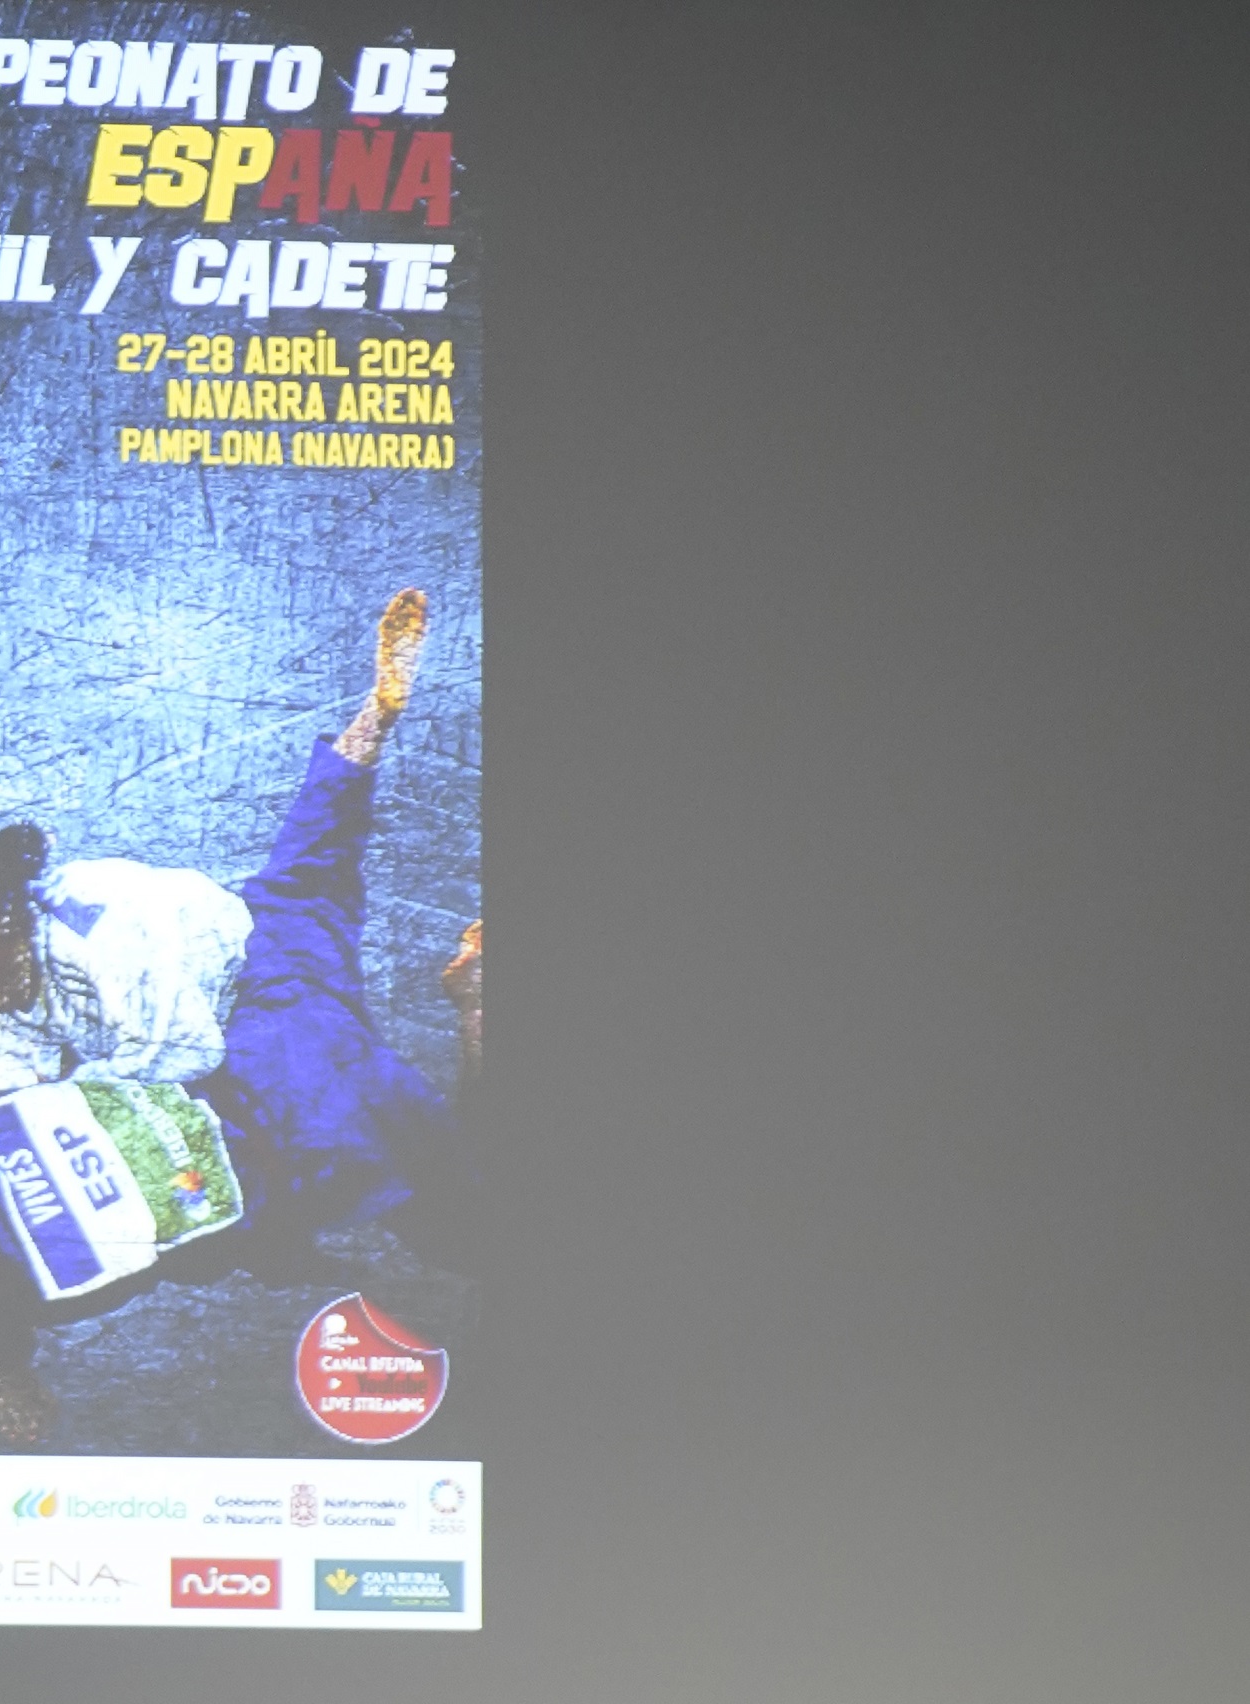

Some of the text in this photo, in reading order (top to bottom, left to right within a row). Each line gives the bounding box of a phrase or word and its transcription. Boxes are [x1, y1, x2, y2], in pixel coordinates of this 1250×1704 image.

[352, 47, 455, 115] DE
[87, 117, 454, 226] ESPAÑA
[79, 236, 143, 314] Y
[170, 239, 455, 317] CADETE
[117, 331, 454, 379] 27-28 ABRIL 2024
[167, 382, 454, 424] NAVARRA ARENA
[120, 430, 455, 470] PAMPLONA (NAVARRA)
[52, 1126, 123, 1212] ESP
[67, 1495, 188, 1519] Iberdrola
